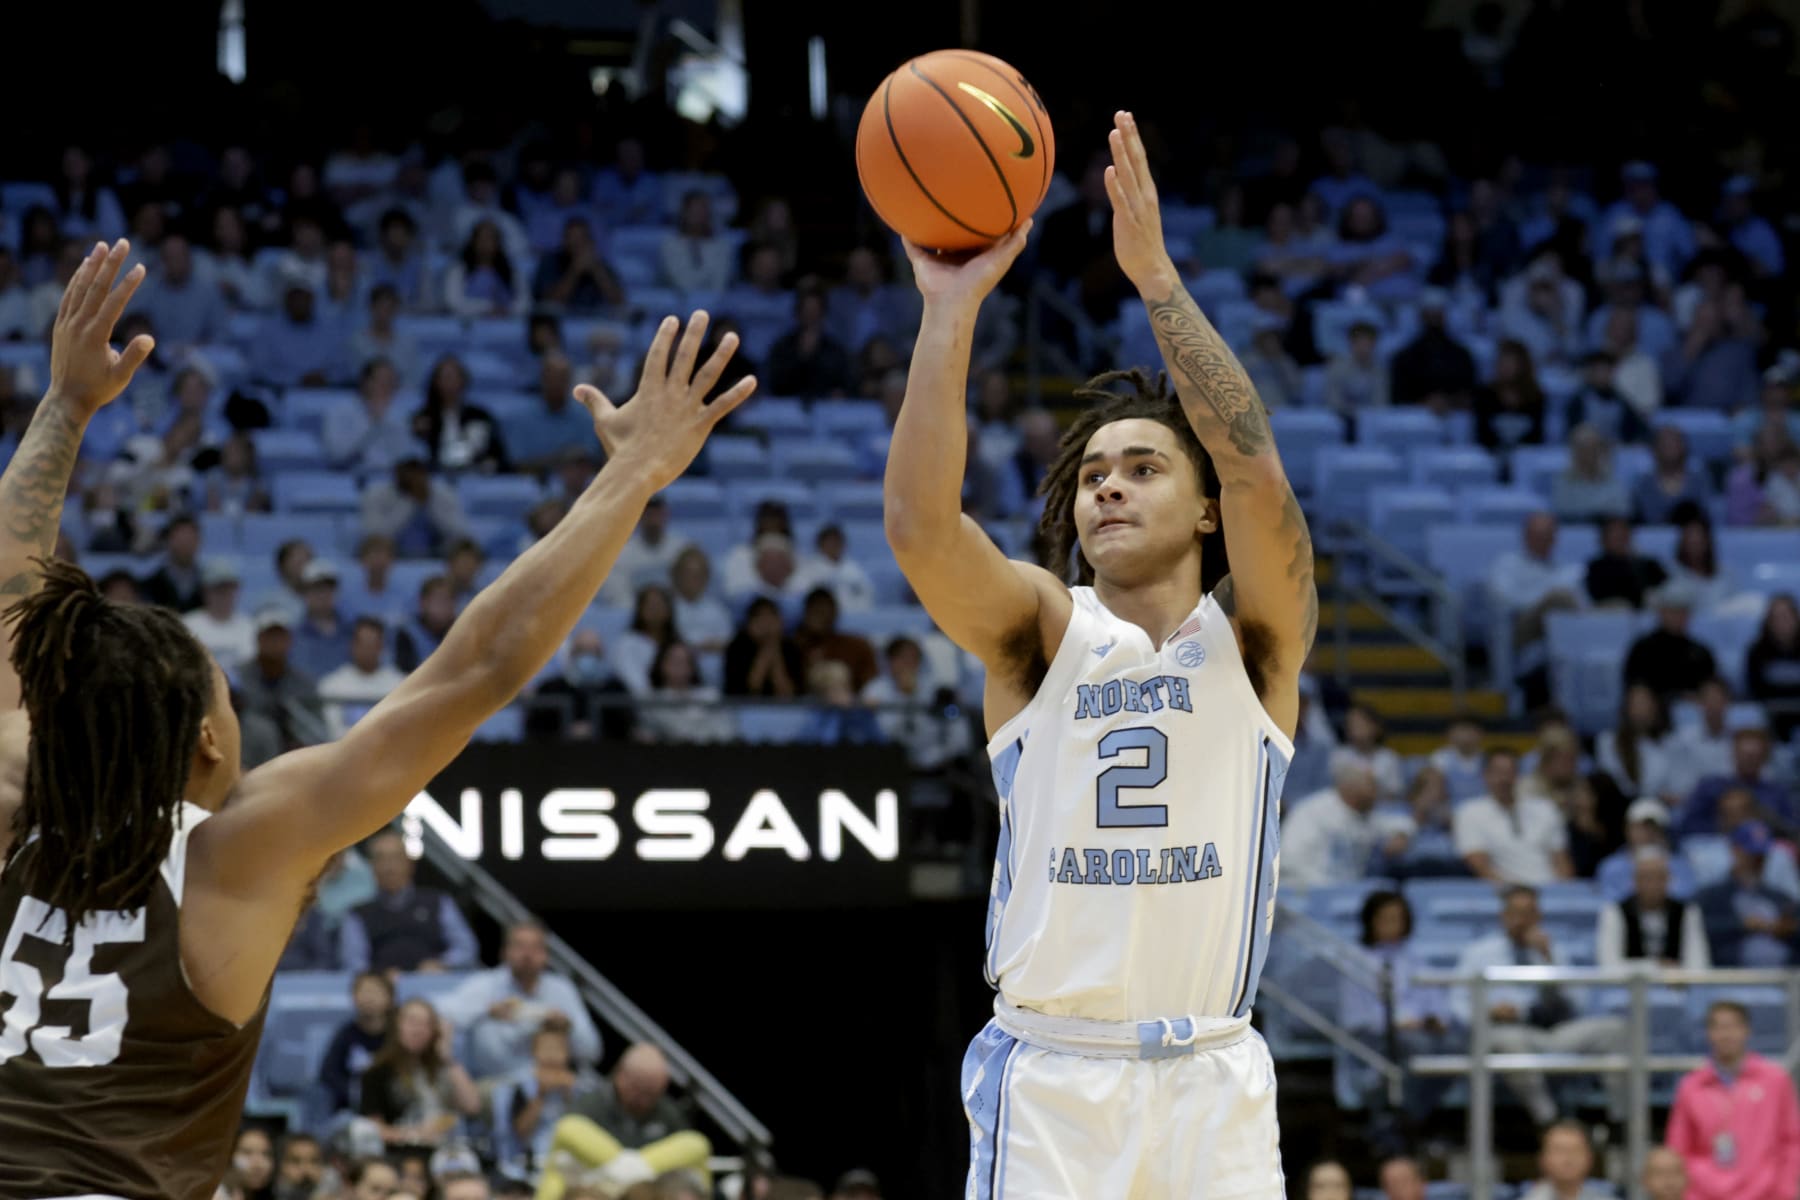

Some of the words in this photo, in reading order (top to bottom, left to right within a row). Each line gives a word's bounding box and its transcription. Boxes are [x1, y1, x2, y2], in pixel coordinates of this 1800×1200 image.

[1074, 675, 1193, 720] NORTH
[1096, 726, 1168, 828] 2
[402, 787, 899, 861] NISSAN
[0, 896, 147, 1067] 55
